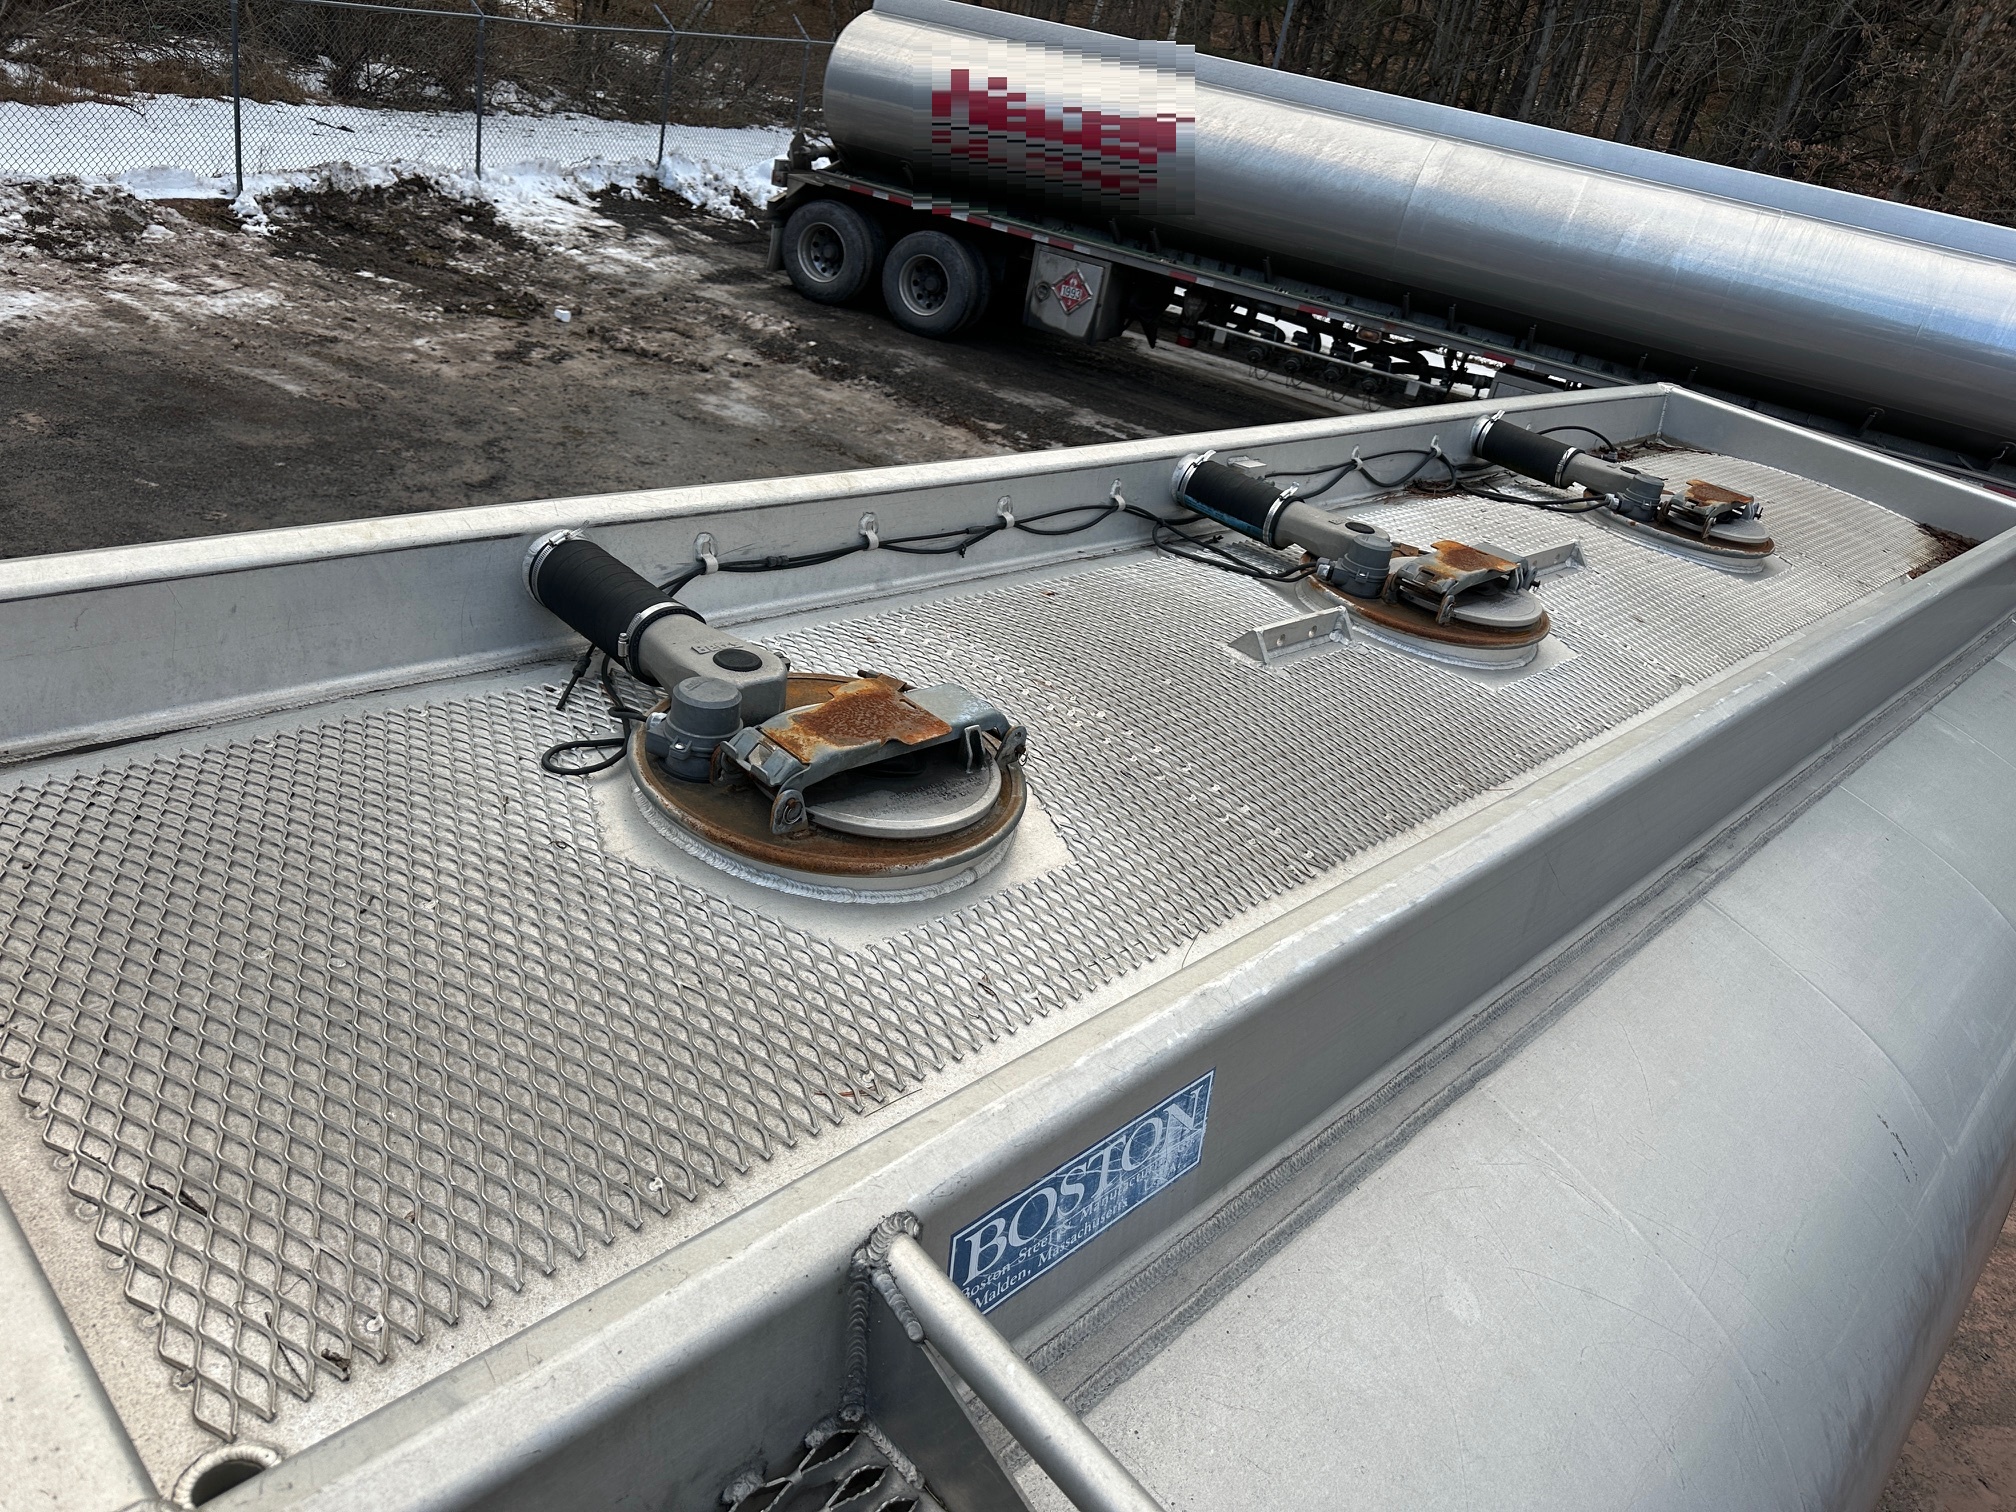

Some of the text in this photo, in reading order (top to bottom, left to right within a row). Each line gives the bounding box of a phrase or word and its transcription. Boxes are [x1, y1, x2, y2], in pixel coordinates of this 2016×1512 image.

[1062, 286, 1081, 300] 1993
[962, 1085, 1204, 1286] BOSTON
[962, 1263, 1011, 1298] Boston
[1017, 1230, 1053, 1263] Steel
[974, 1268, 1031, 1308] Malden,
